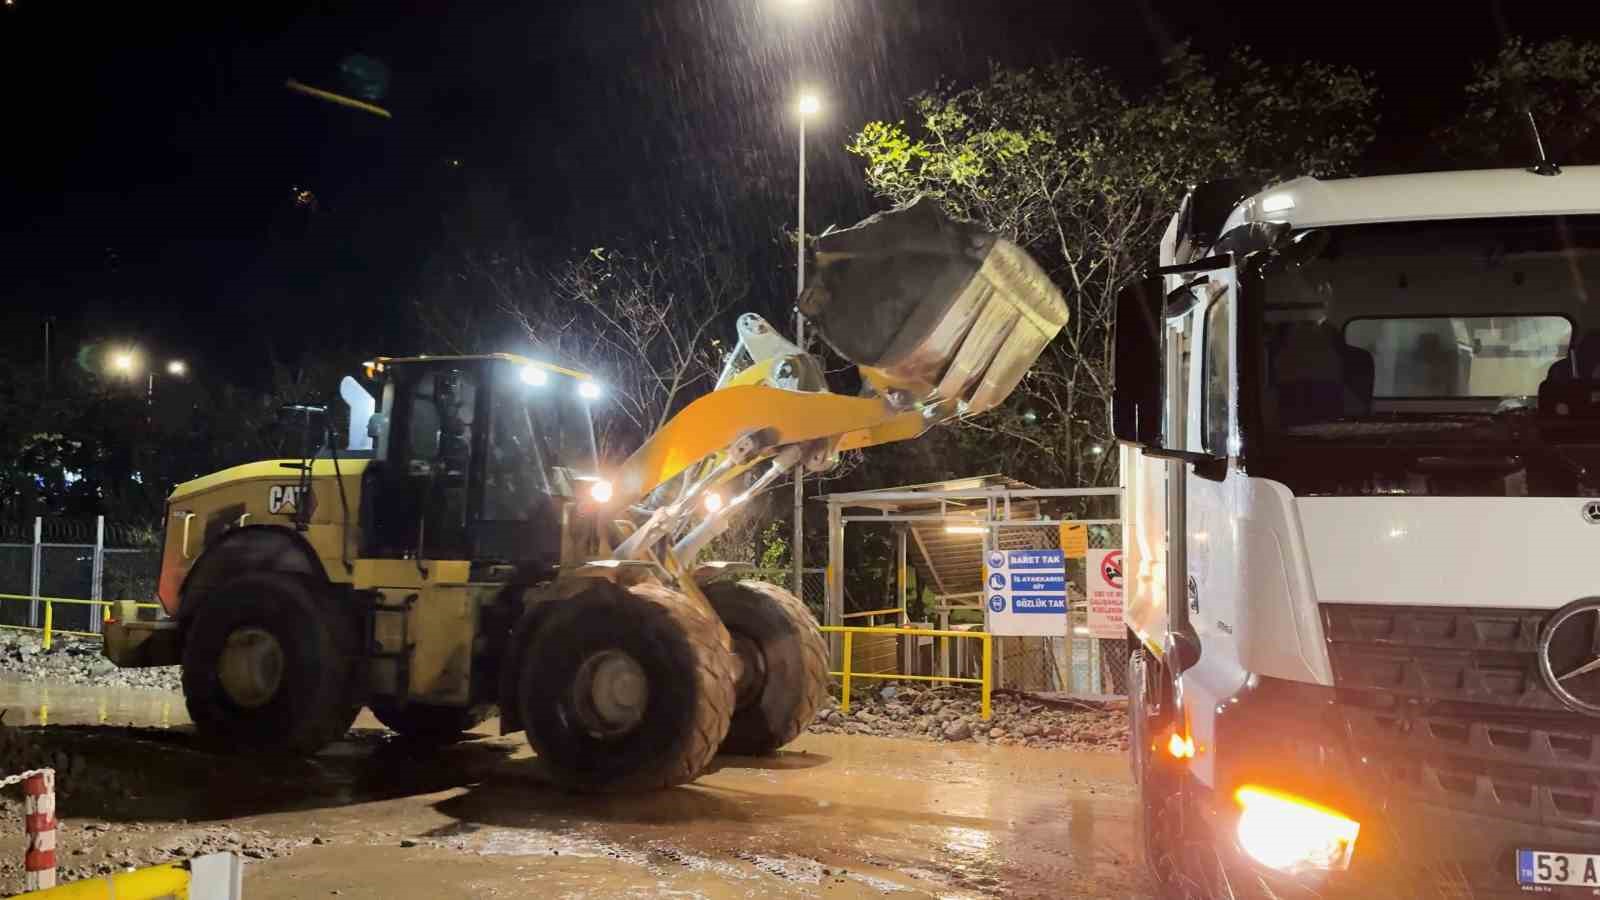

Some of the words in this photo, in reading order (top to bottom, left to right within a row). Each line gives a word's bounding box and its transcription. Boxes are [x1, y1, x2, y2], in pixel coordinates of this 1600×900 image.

[1042, 555, 1061, 564] TAK
[1015, 598, 1048, 608] GÖZLÜK
[1049, 600, 1065, 608] TAK
[1537, 854, 1569, 882] 53
[1583, 857, 1598, 883] A
